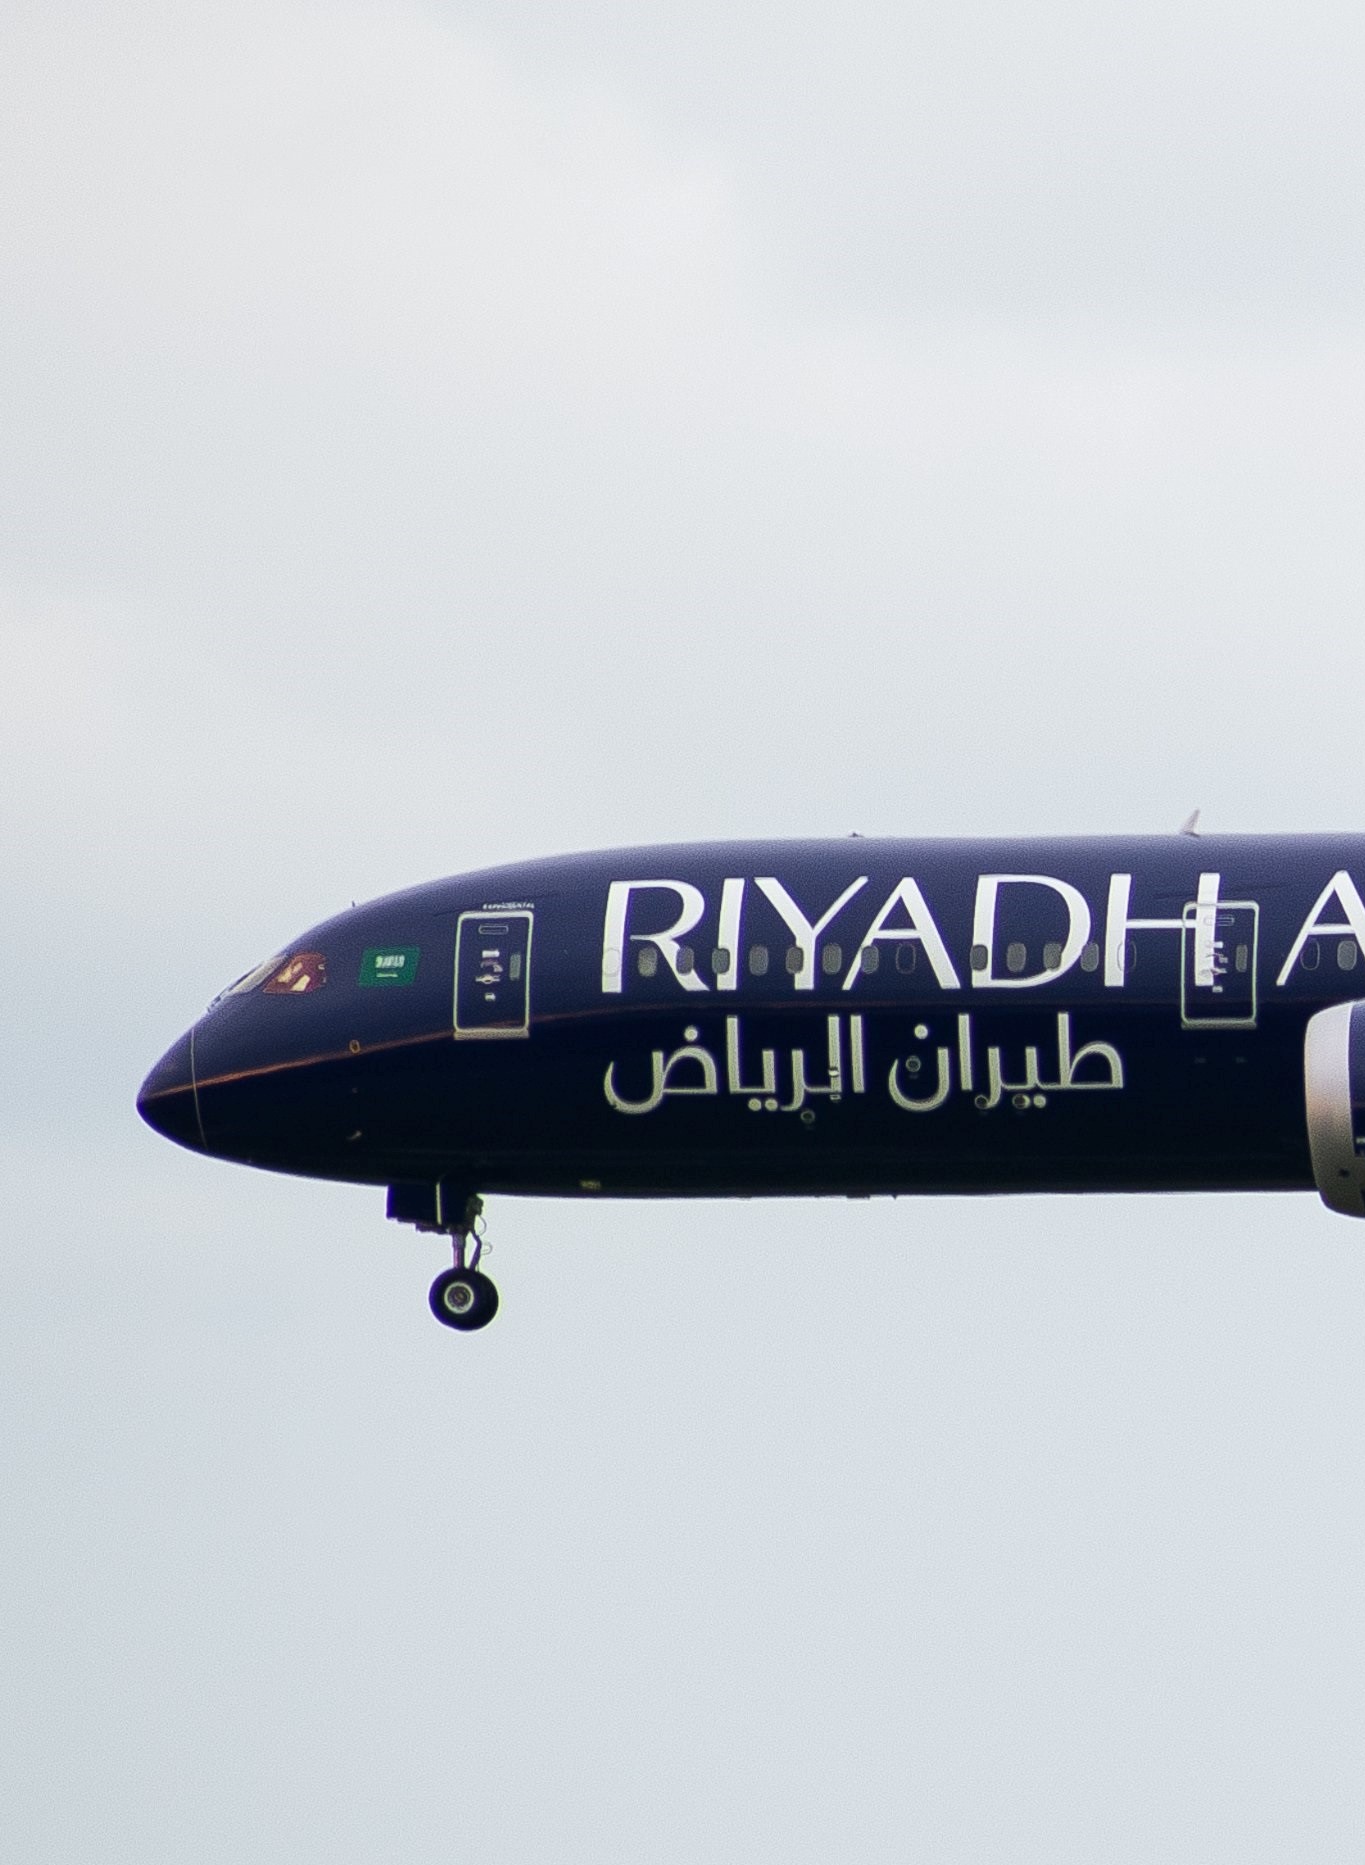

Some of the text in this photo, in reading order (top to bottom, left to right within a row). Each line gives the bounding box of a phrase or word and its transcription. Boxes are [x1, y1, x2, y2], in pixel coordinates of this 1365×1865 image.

[602, 873, 1220, 993] RIYADH
[604, 1012, 1124, 1115] طيران الرياض
